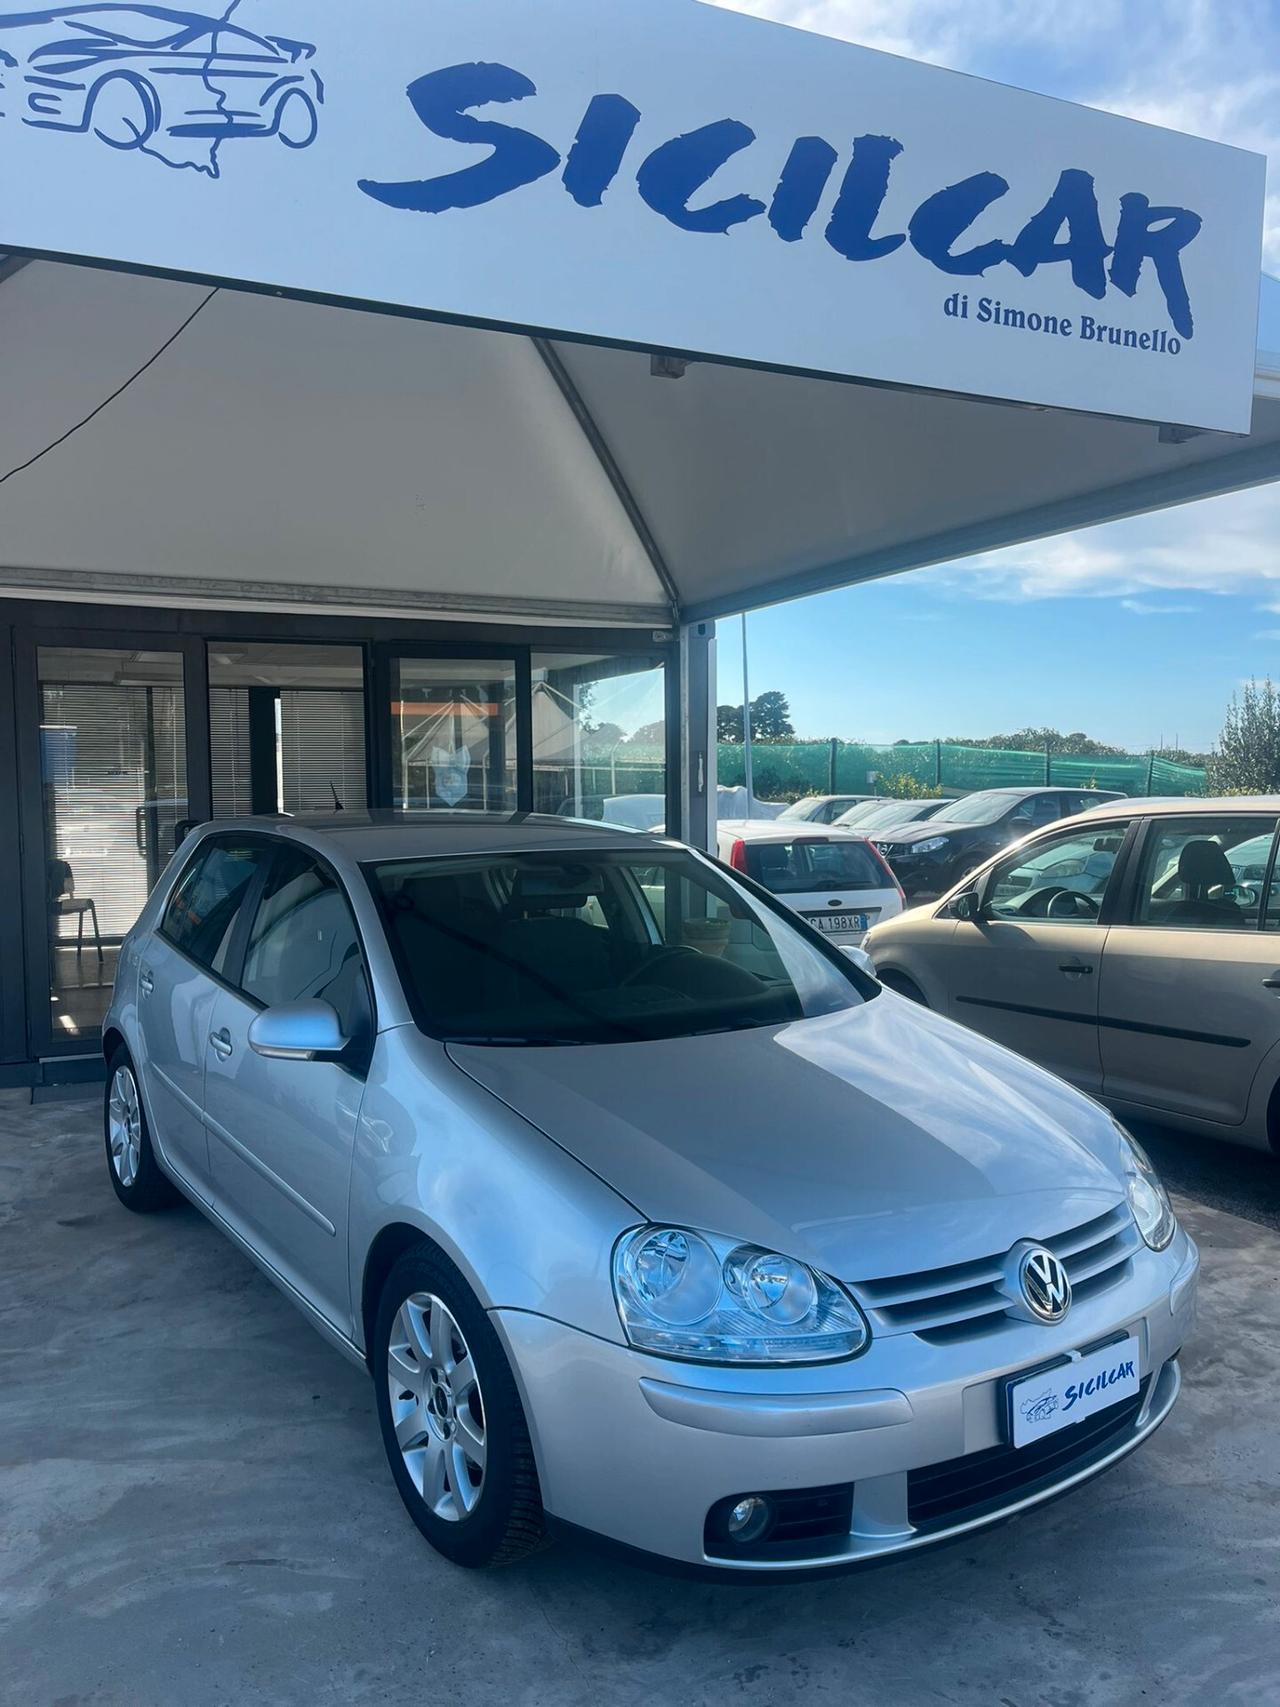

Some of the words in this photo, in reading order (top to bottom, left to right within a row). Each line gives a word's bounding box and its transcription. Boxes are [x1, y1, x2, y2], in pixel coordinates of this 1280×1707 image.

[357, 61, 1202, 340] SICILCAR
[943, 292, 969, 319] di
[976, 297, 1073, 337] Simone
[1079, 315, 1182, 356] Brunello
[828, 916, 860, 930] 198XR
[1061, 1361, 1135, 1411] SICILCAR
